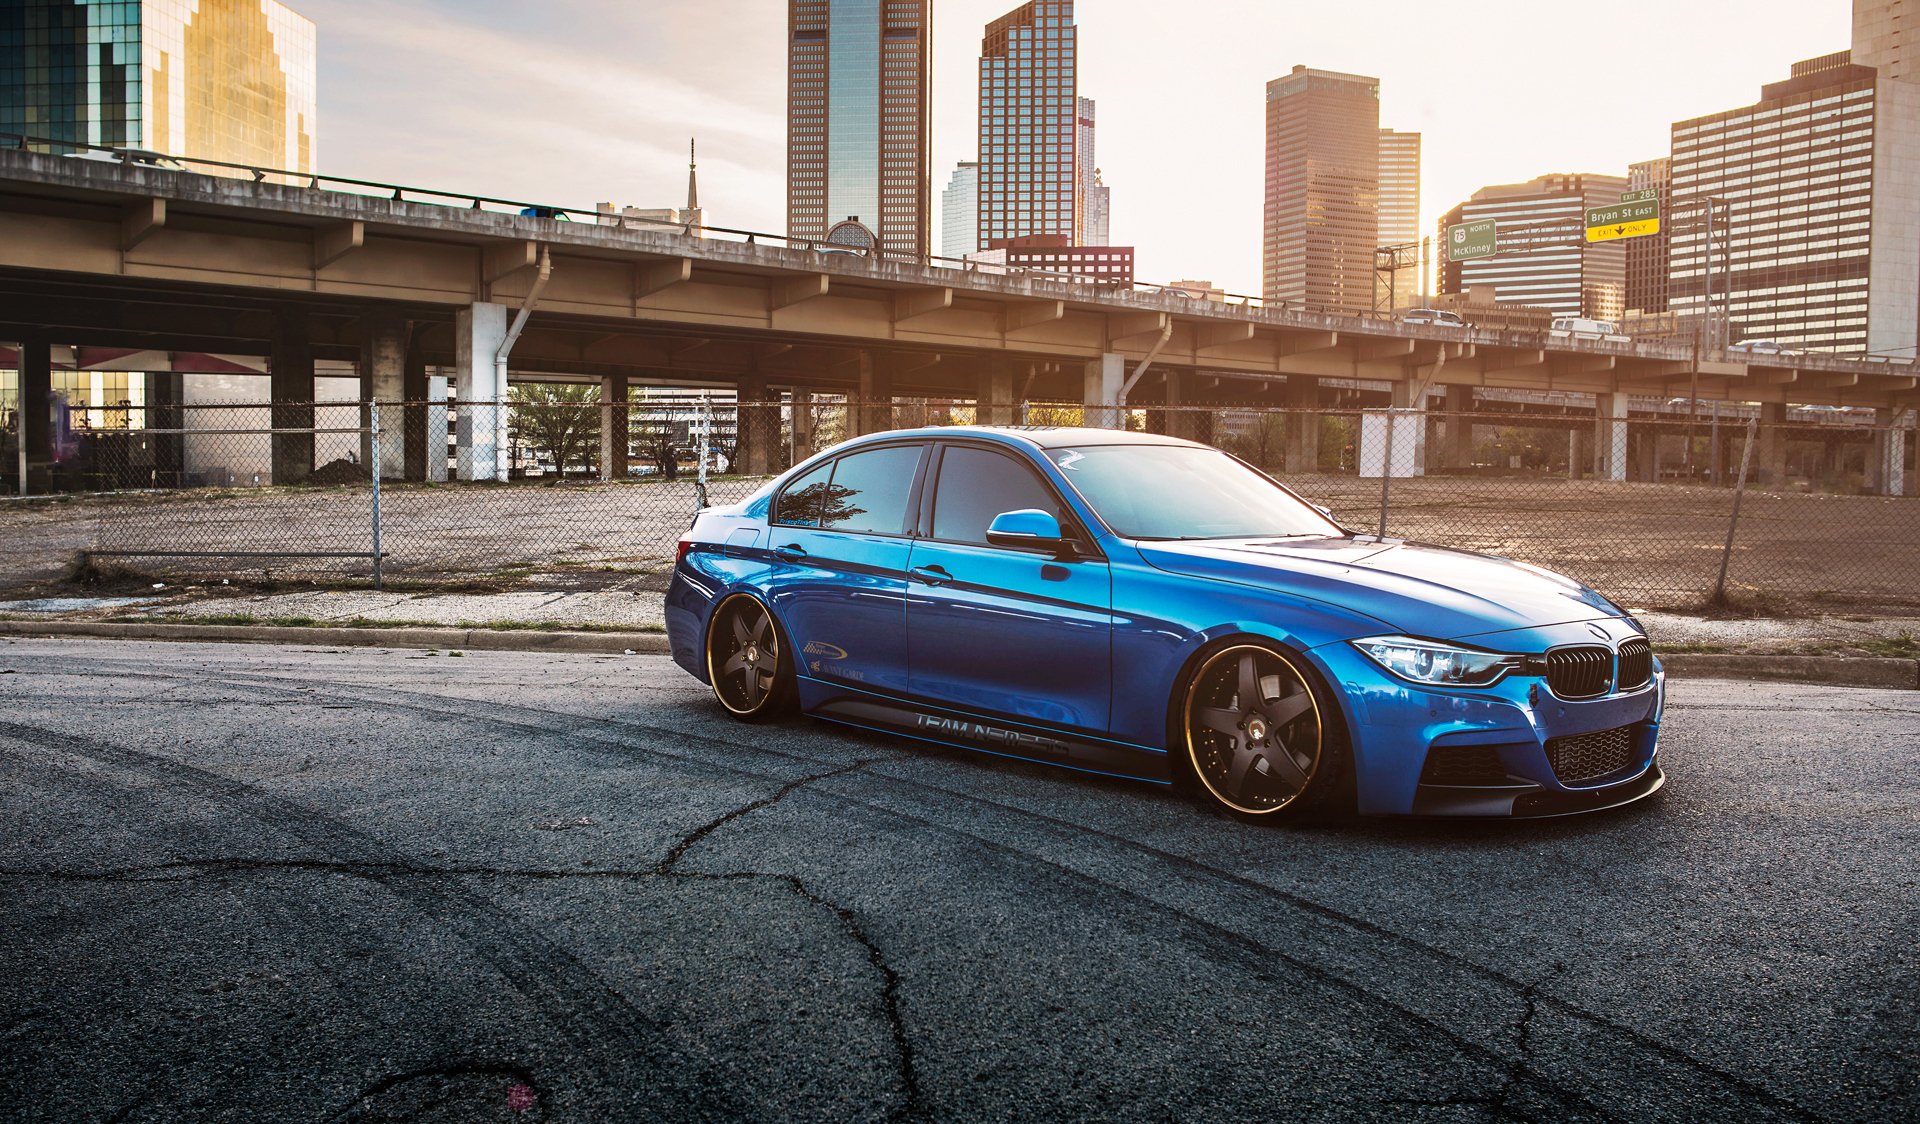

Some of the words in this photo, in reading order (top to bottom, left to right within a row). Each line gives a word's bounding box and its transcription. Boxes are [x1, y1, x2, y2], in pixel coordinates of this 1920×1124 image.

[1640, 189, 1656, 199] 285
[1591, 211, 1618, 223] Bryan
[1622, 208, 1632, 218] St
[1635, 207, 1653, 216] EAST
[1470, 224, 1490, 233] NORTH
[1598, 229, 1612, 237] EXIT
[1628, 224, 1647, 233] ONLY
[1456, 232, 1465, 241] 75
[1454, 244, 1491, 256] McKinney
[916, 713, 968, 737] TEAM
